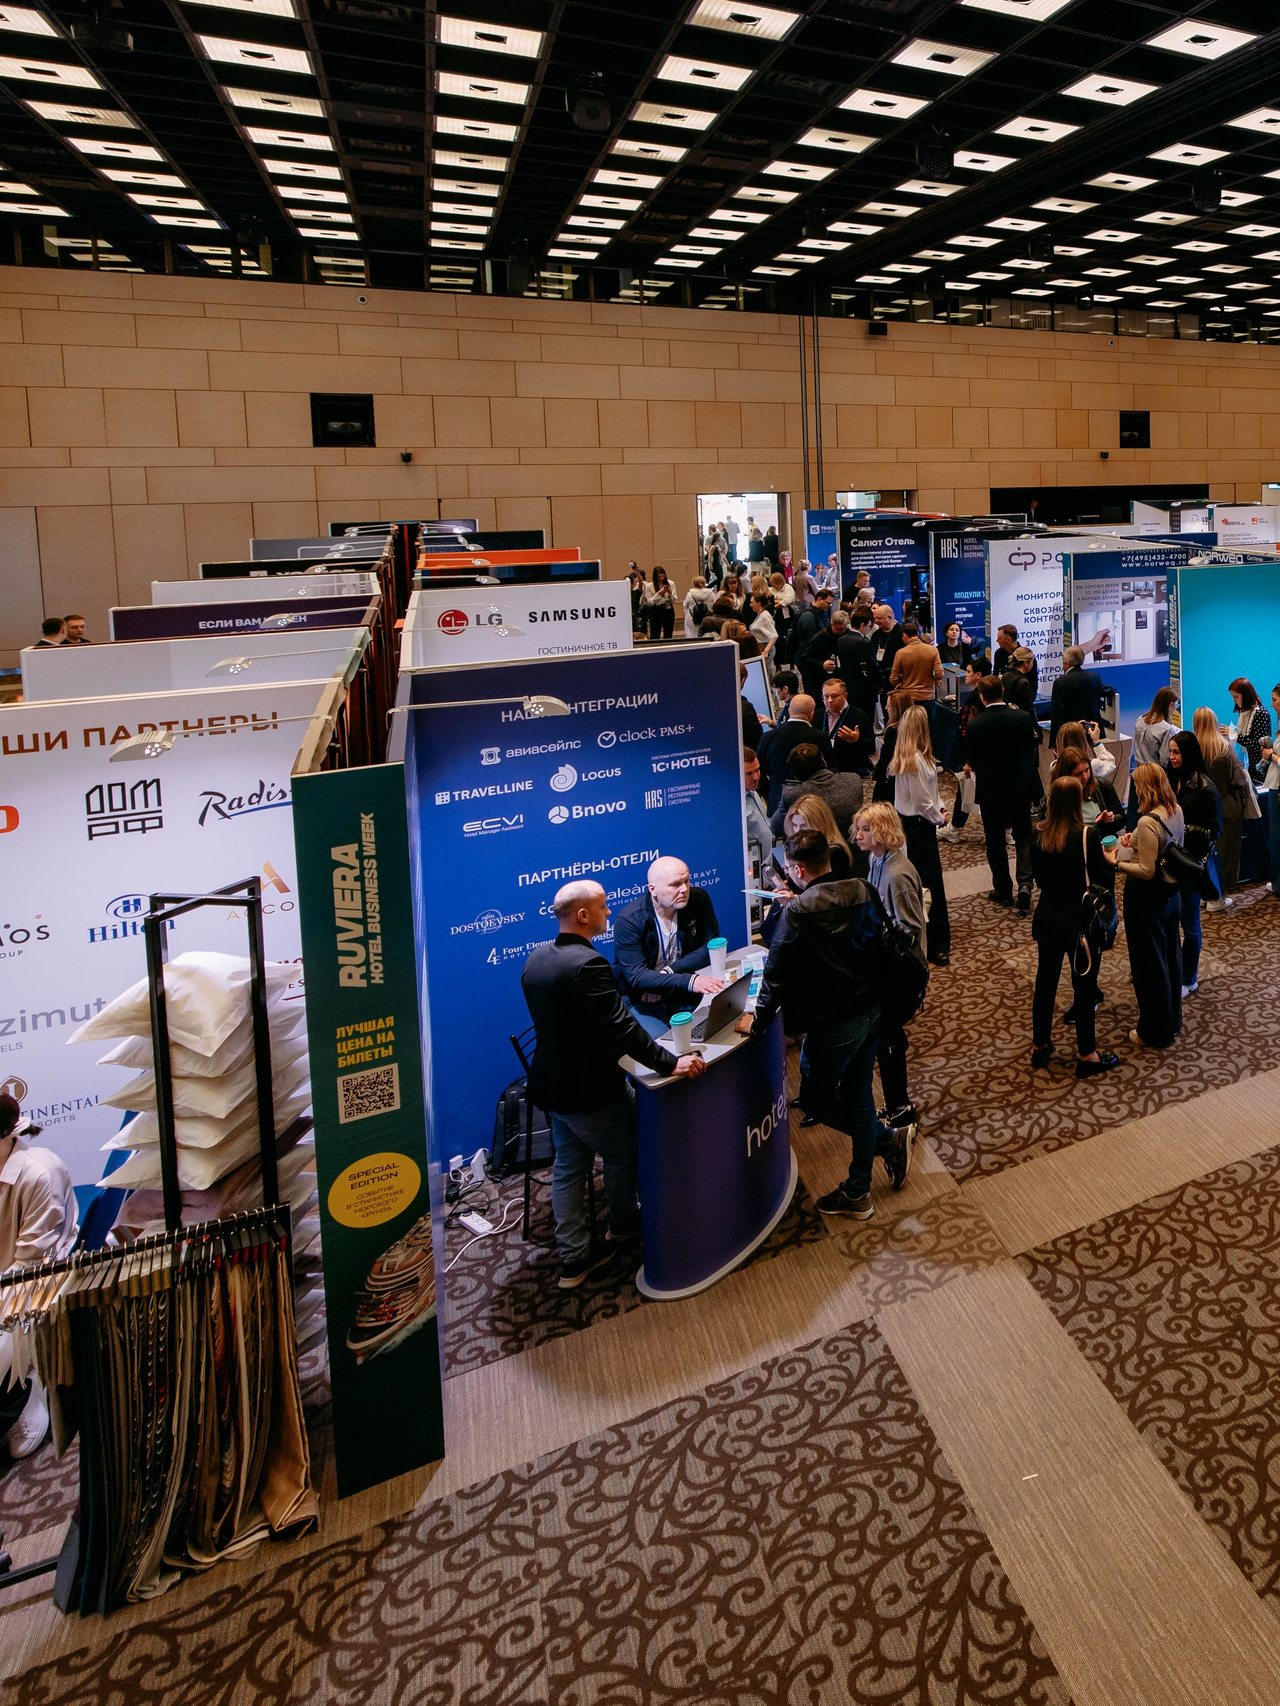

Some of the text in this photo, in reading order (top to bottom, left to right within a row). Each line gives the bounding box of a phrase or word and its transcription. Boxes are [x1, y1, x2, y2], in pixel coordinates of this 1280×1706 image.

[850, 537, 915, 547] Салют Отель
[940, 538, 958, 559] HRS
[1121, 553, 1187, 562] +7(495)432-4700
[1121, 560, 1187, 568] www.norweq.ru
[954, 591, 981, 599] МОДУЛИ
[198, 617, 233, 631] ЕСЛИ
[235, 616, 263, 628] ВАМ
[476, 606, 617, 626] LG SAMSUNG
[537, 642, 618, 655] ГОСТИНИЧНОЕ ТВ
[501, 692, 659, 723] НА НТЕГРАЦИИ
[83, 712, 278, 748] ПАРТНЕРЫ
[619, 723, 695, 744] clock PMS+
[505, 739, 582, 759] авиасейлс
[671, 755, 712, 770] HOTEL
[452, 767, 622, 801] TRAVELLINE LOGUS
[198, 779, 293, 827] Radis
[645, 789, 663, 810] HRS
[463, 800, 627, 833] ECVI Bnovo
[518, 849, 660, 887] ПАРТНЁРЫ-ОТЕЛИ
[360, 812, 385, 985] HOTEL BUSINESS WEEK
[330, 842, 368, 988] RUVIERA
[450, 912, 526, 935] DOSTOEVSKY
[87, 917, 177, 945] Hiltn
[503, 946, 524, 955] Four
[336, 1015, 395, 1039] ЛУЧШАЯ
[336, 1029, 396, 1055] ЦЕНА НА
[337, 1045, 394, 1068] БИЛЕТЫ
[348, 1161, 401, 1182] SPECIAL
[350, 1171, 399, 1190] EDITION
[352, 1188, 405, 1209] СТИЛИСТИКЕ
[356, 1184, 394, 1200] СОБЫТИЕ
[354, 1197, 398, 1215] МОРСКОГО
[361, 1206, 392, 1220] КРУИЗА
